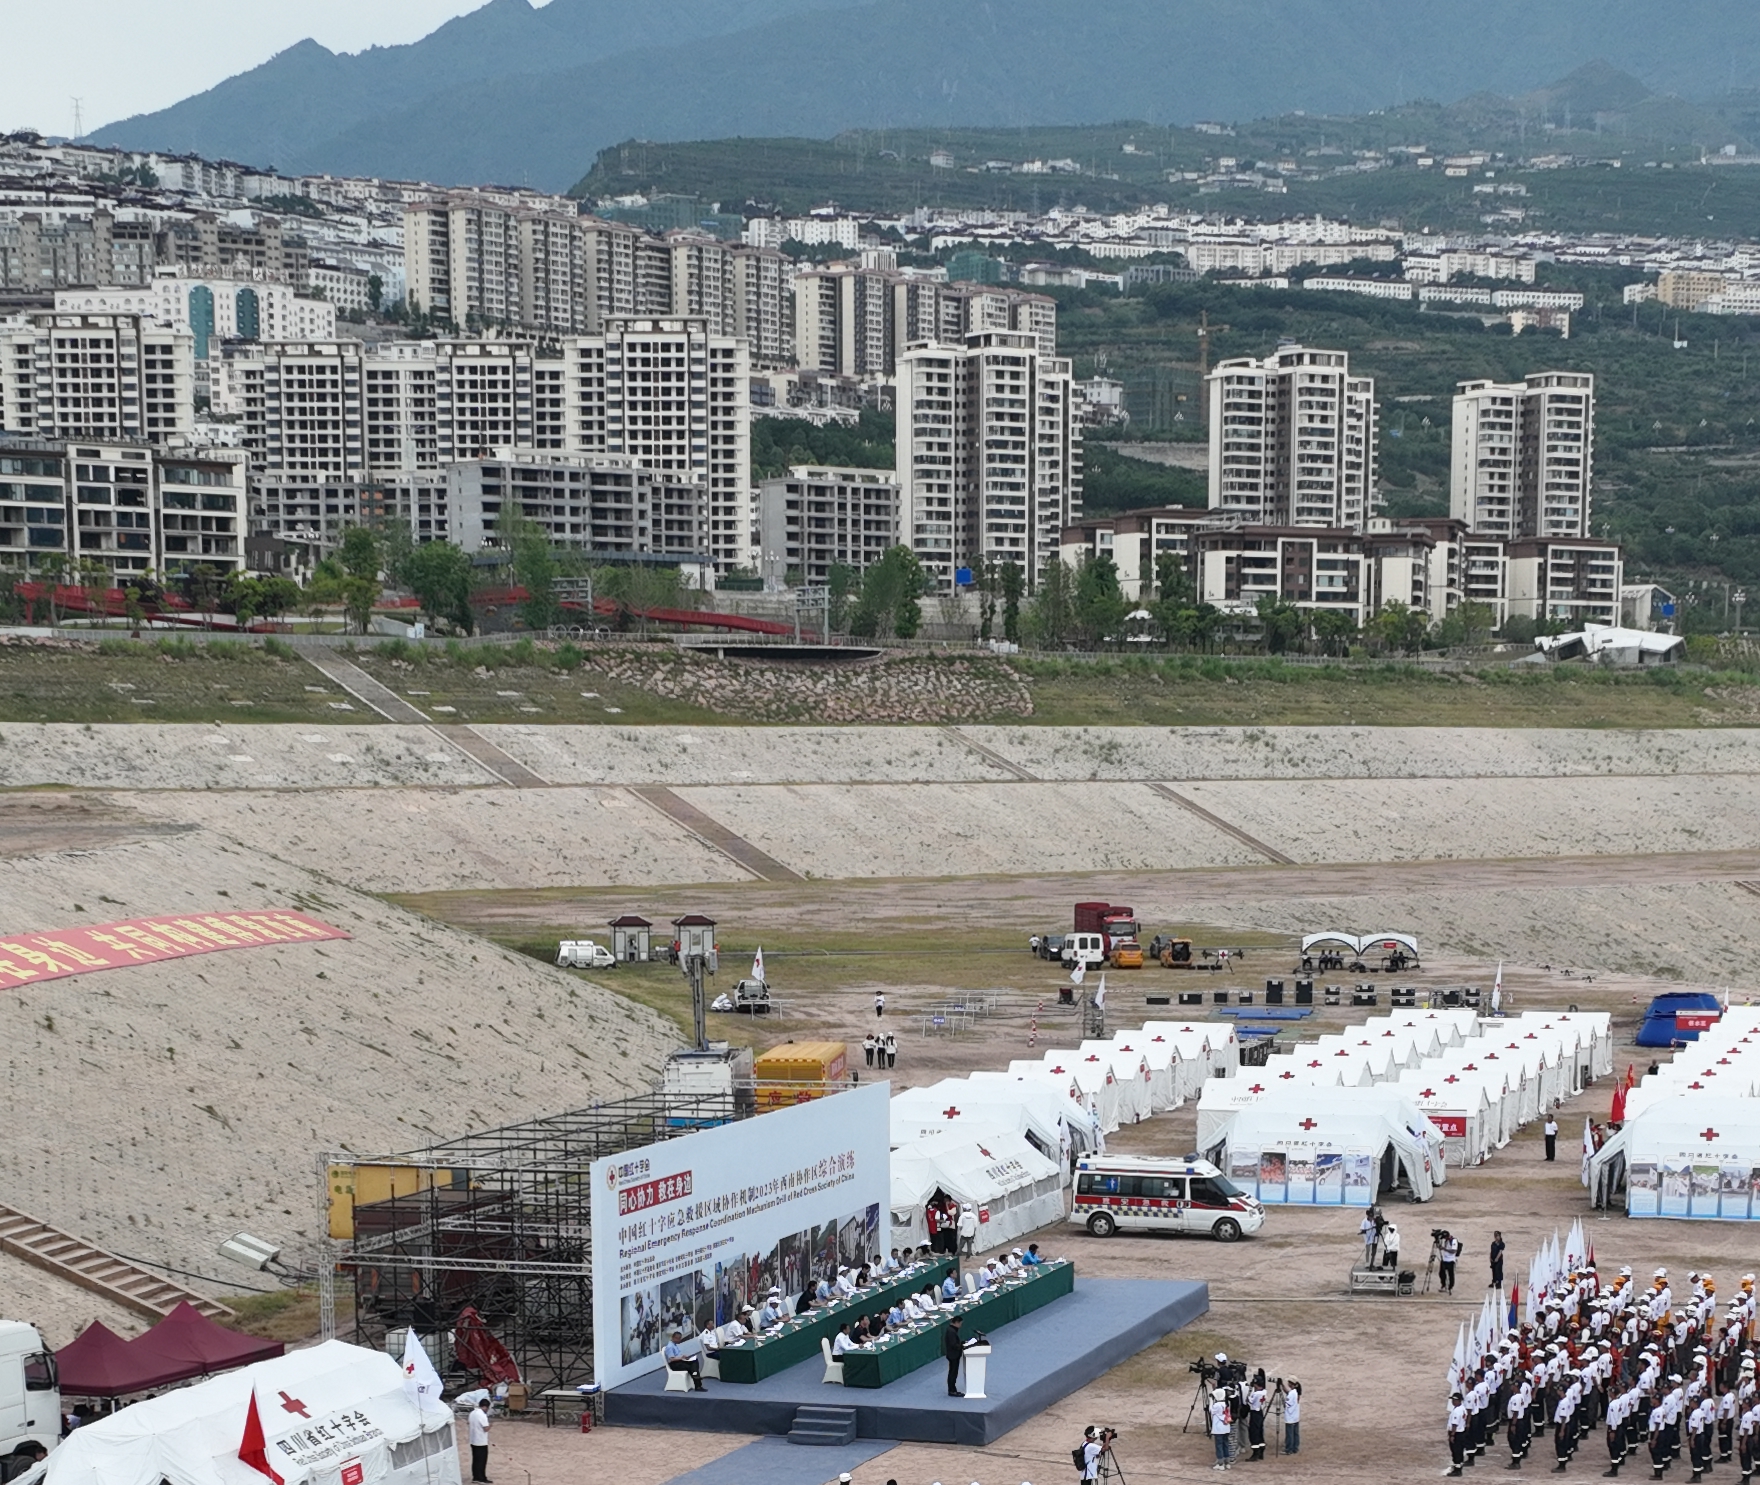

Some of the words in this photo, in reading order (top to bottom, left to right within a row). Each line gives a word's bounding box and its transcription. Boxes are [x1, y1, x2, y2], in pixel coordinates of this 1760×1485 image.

[276, 1410, 371, 1456] 四川省红十字会
